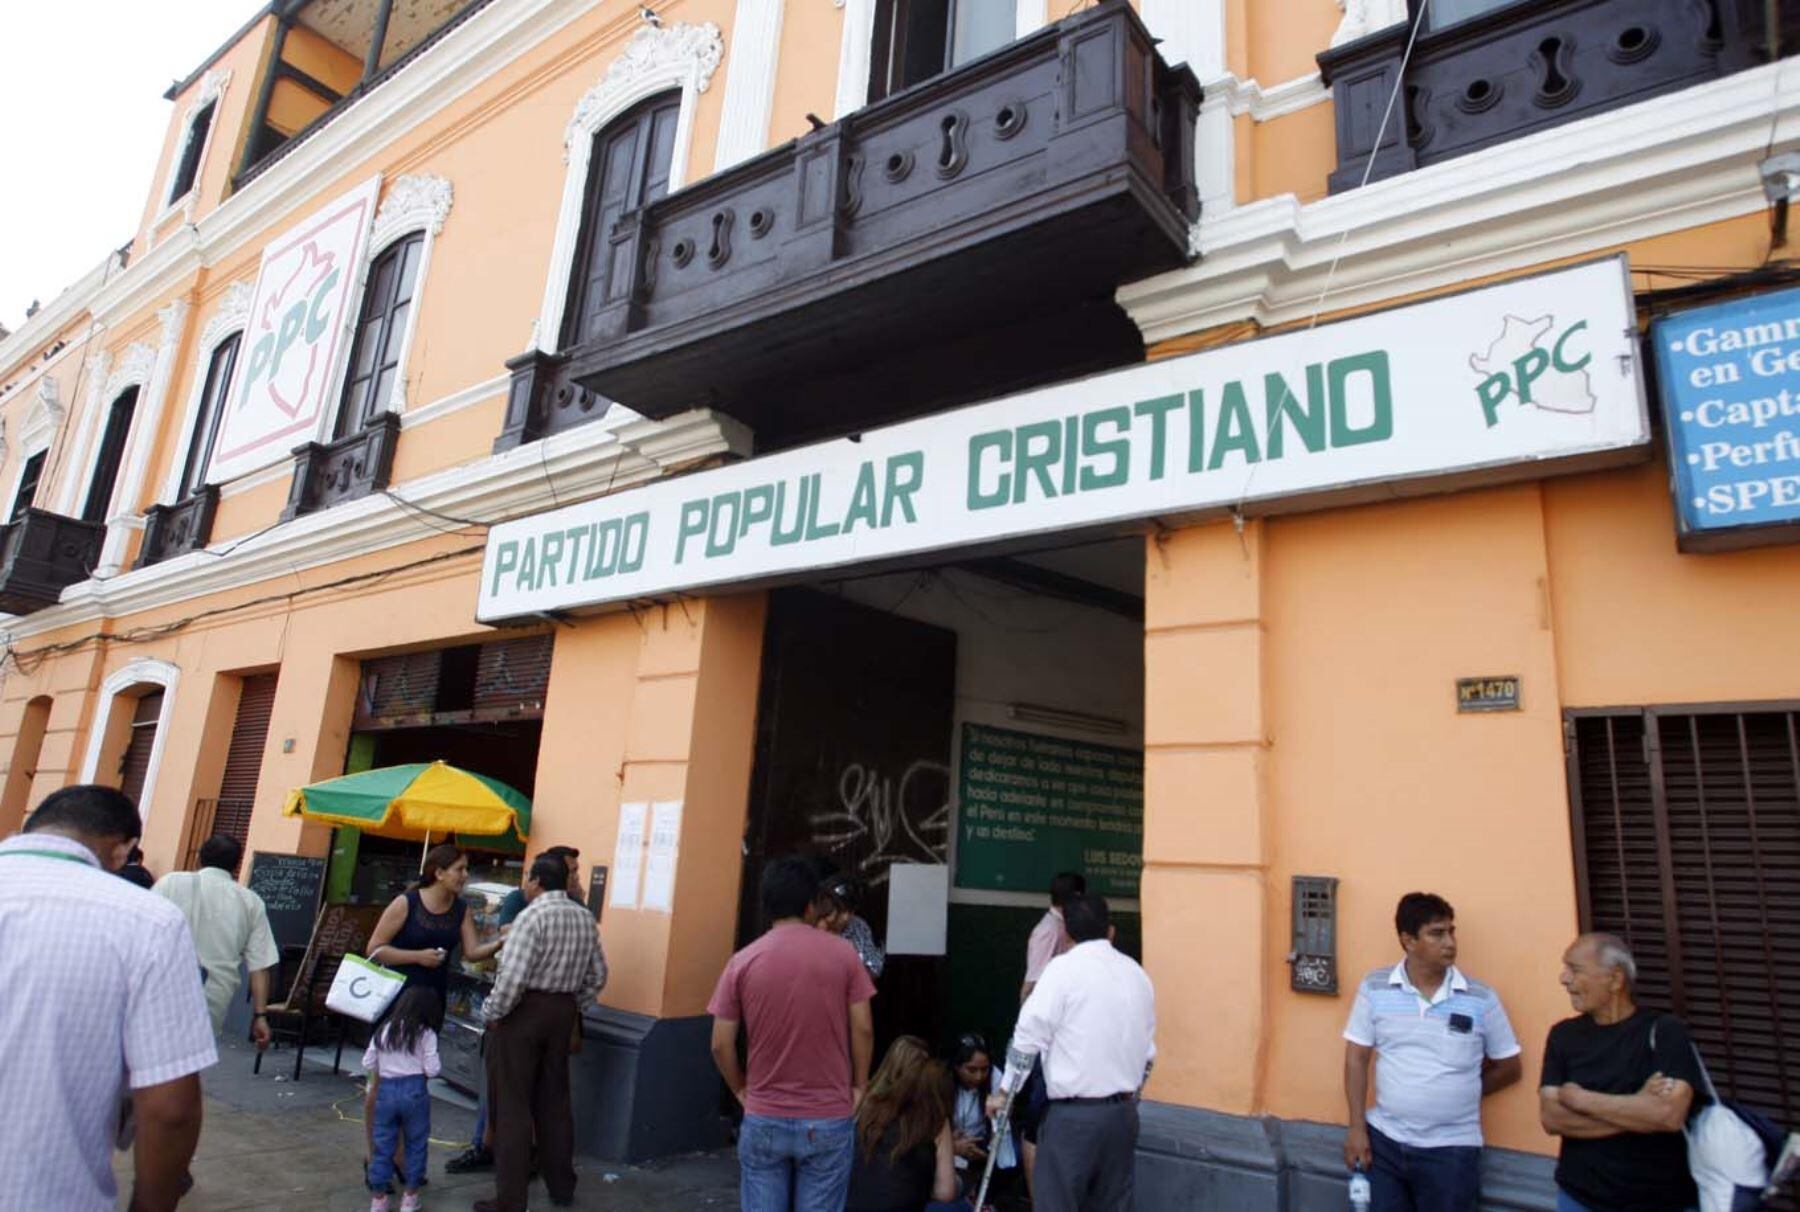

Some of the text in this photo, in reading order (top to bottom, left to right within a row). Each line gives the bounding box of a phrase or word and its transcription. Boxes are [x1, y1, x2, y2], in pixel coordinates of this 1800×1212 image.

[238, 266, 340, 411] PPC
[1473, 320, 1592, 429] PPC
[1690, 361, 1740, 388] en
[1695, 389, 1800, 428] Capt
[490, 350, 1393, 598] PARTIDO POPULAR CRISTIANO
[1083, 848, 1107, 864] LUIS
